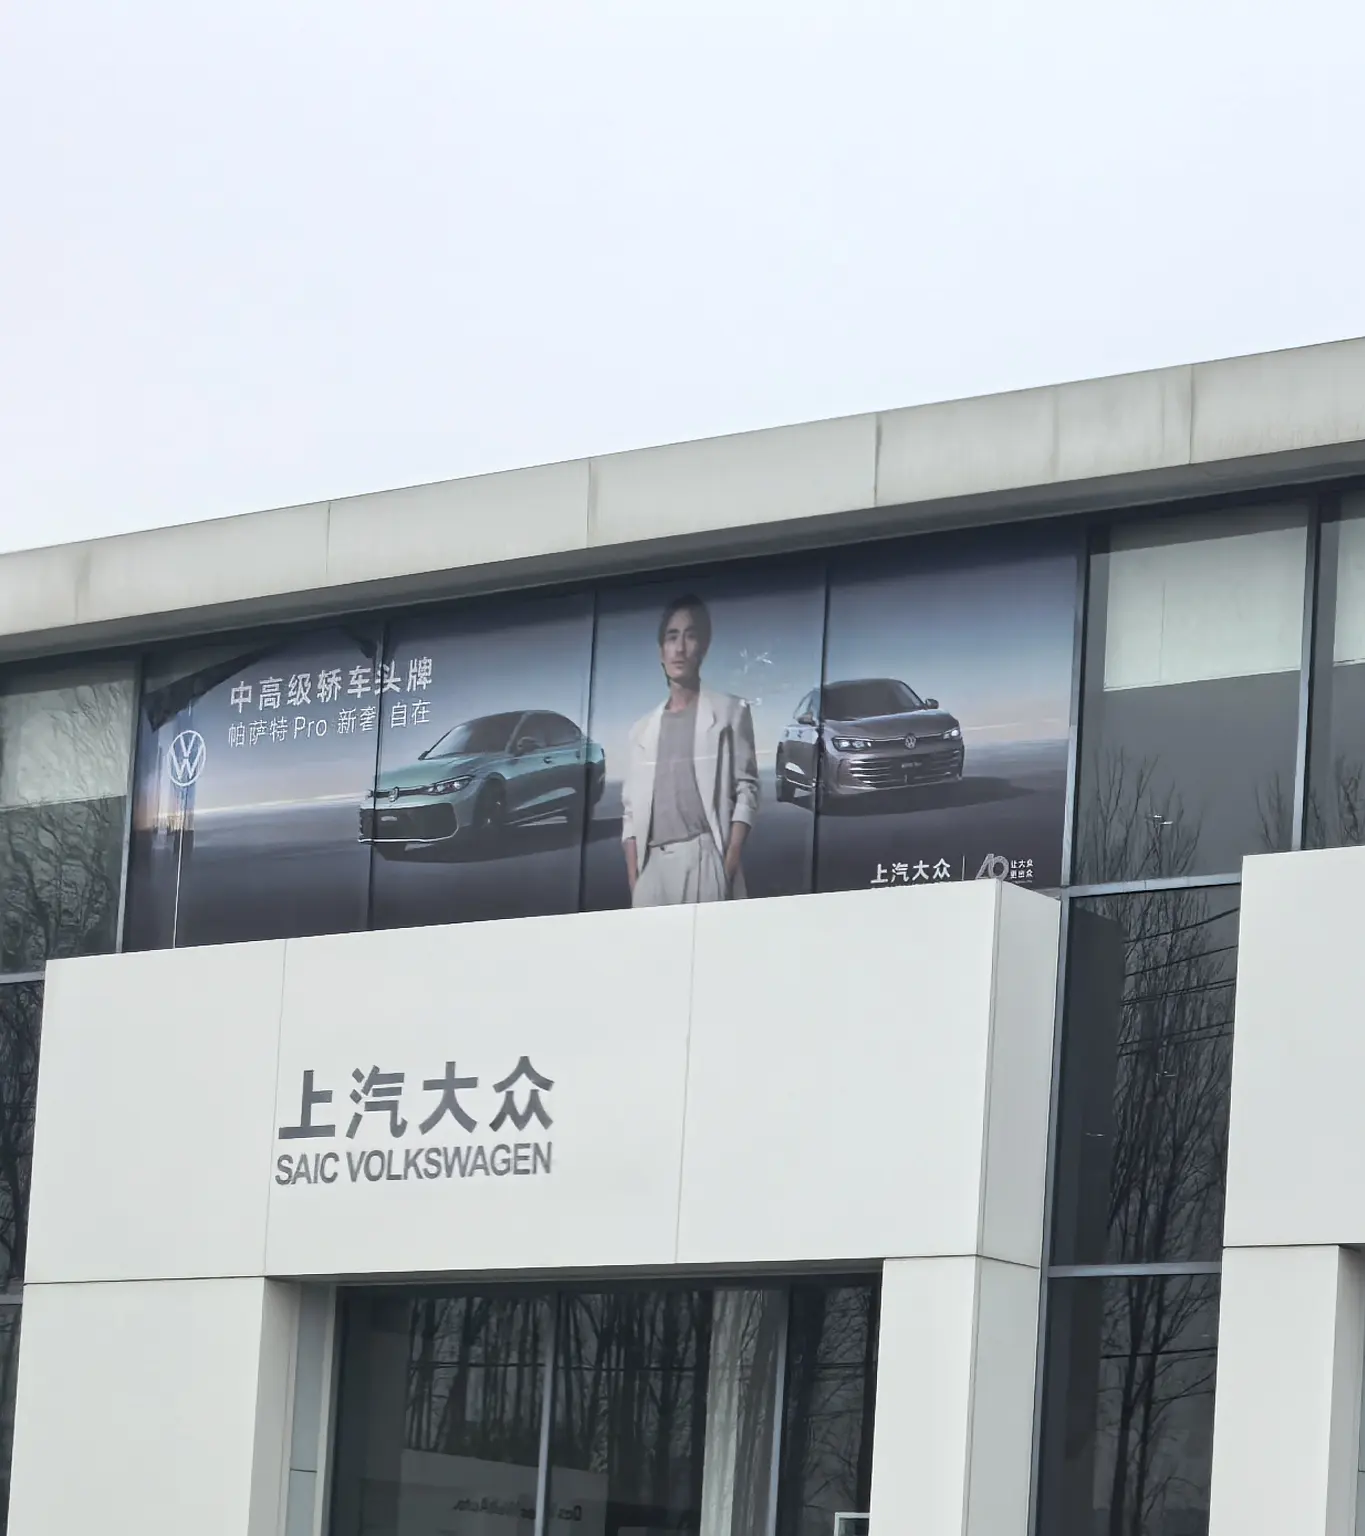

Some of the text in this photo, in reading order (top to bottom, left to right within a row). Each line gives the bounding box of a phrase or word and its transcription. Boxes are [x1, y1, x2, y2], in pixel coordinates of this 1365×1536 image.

[229, 655, 433, 714] 中高级轿车头牌
[870, 857, 951, 884] 上汽大众
[277, 1055, 555, 1140] 上汽大众
[274, 1140, 553, 1186] SAIC VOLKSWAGEN
